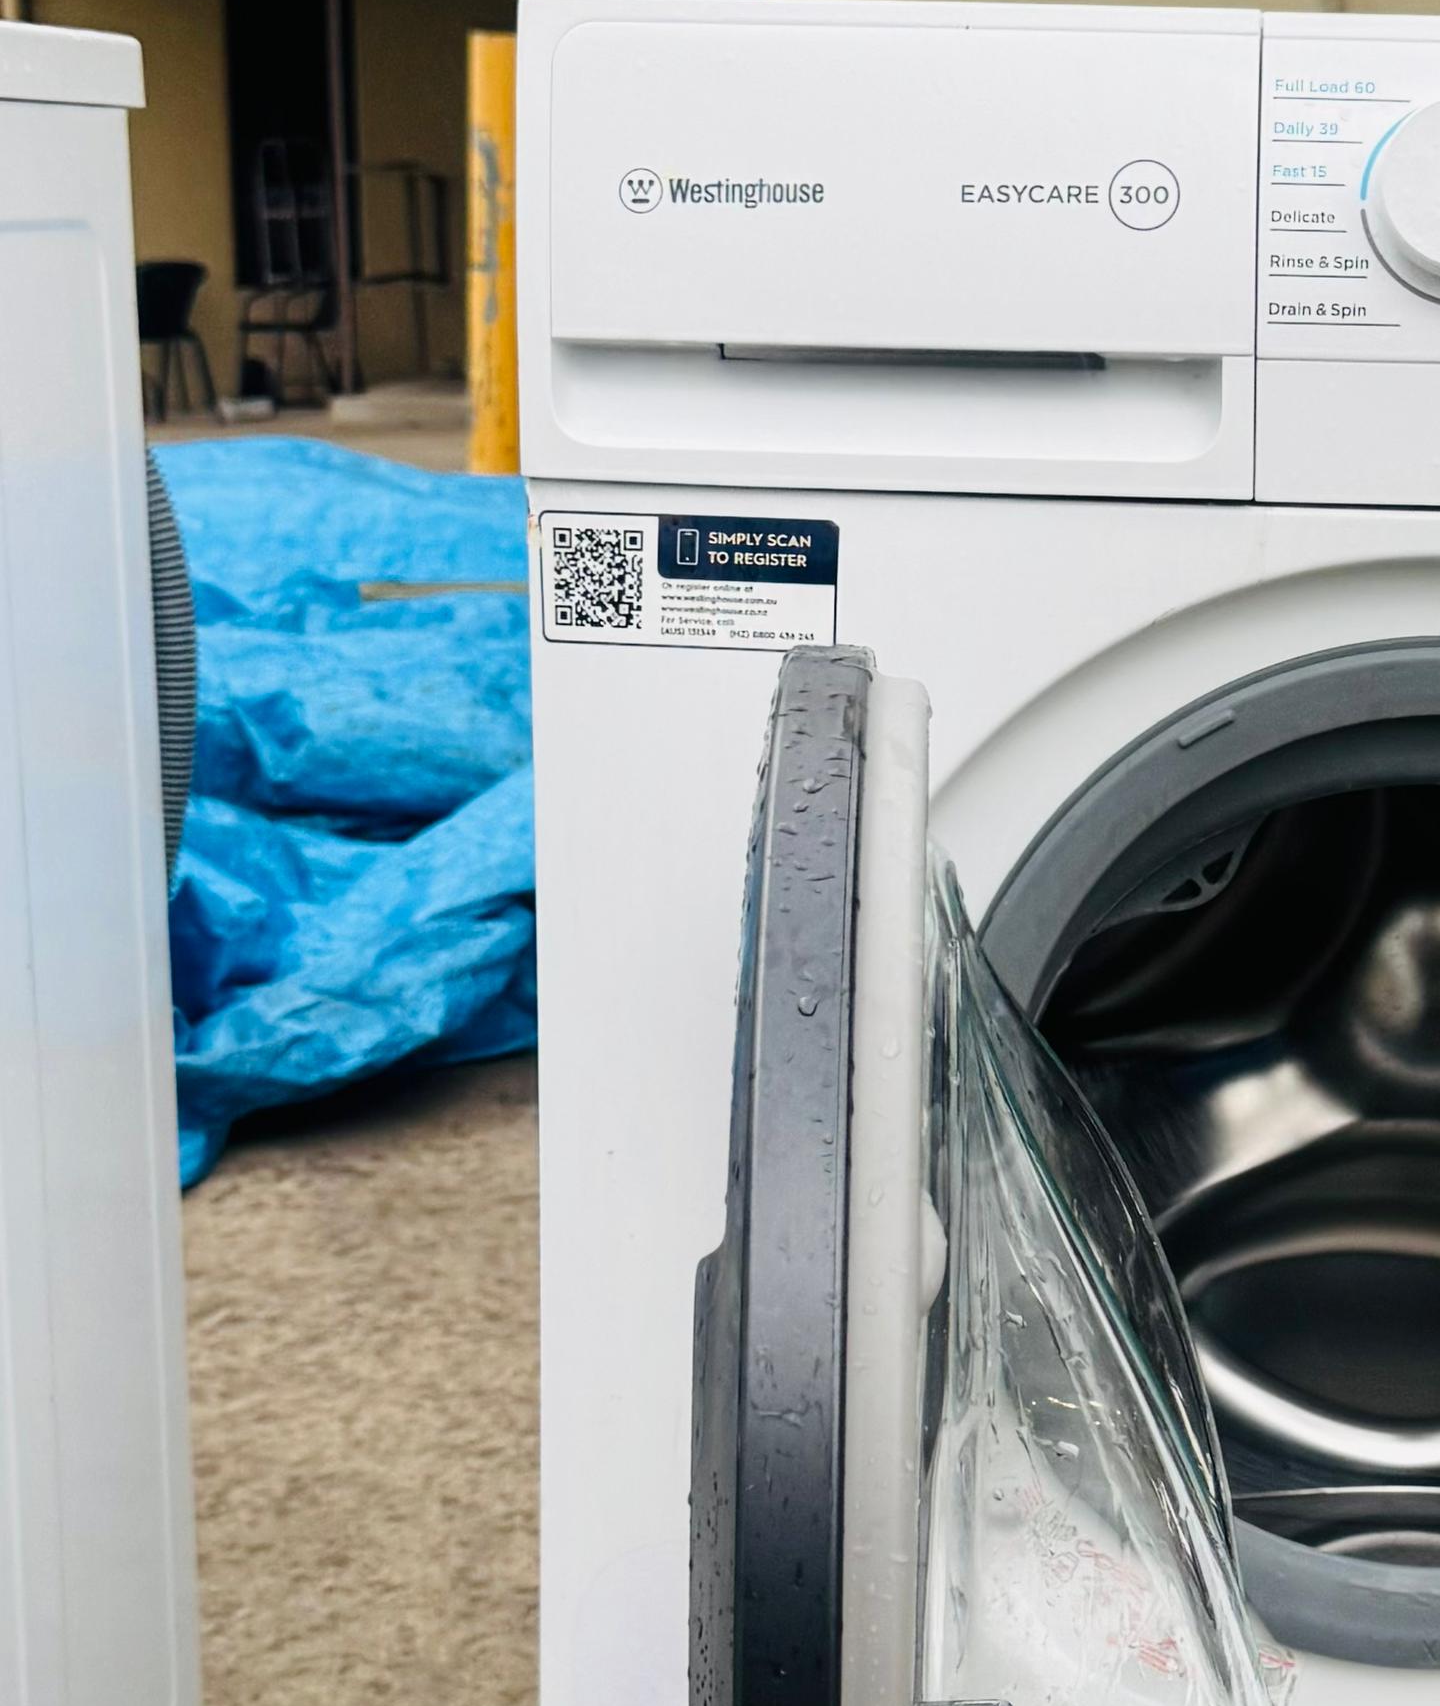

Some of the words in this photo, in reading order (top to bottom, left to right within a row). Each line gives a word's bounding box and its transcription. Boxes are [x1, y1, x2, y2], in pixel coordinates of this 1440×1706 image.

[1275, 78, 1304, 92] Full
[1309, 80, 1349, 94] Load
[1354, 81, 1376, 94] 60
[1274, 121, 1314, 137] Daily
[1319, 122, 1339, 135] 39
[1272, 164, 1306, 178] Fast
[1311, 165, 1327, 178] 15
[669, 178, 824, 208] Westinghouse
[961, 184, 1099, 204] EASYCARE
[1119, 185, 1170, 204] 300
[1271, 210, 1336, 224] Delicate
[1270, 254, 1314, 269] Rinse
[1318, 256, 1329, 269] &
[1333, 255, 1369, 271] Spin
[1268, 302, 1312, 316] Drain
[1316, 303, 1327, 317] &
[1330, 302, 1367, 320] Spin
[708, 532, 763, 546] SIMPLY
[767, 534, 811, 547] SCAN
[708, 551, 729, 564] TO
[734, 552, 807, 568] REGISTER
[676, 584, 710, 592] register
[661, 615, 675, 624] For
